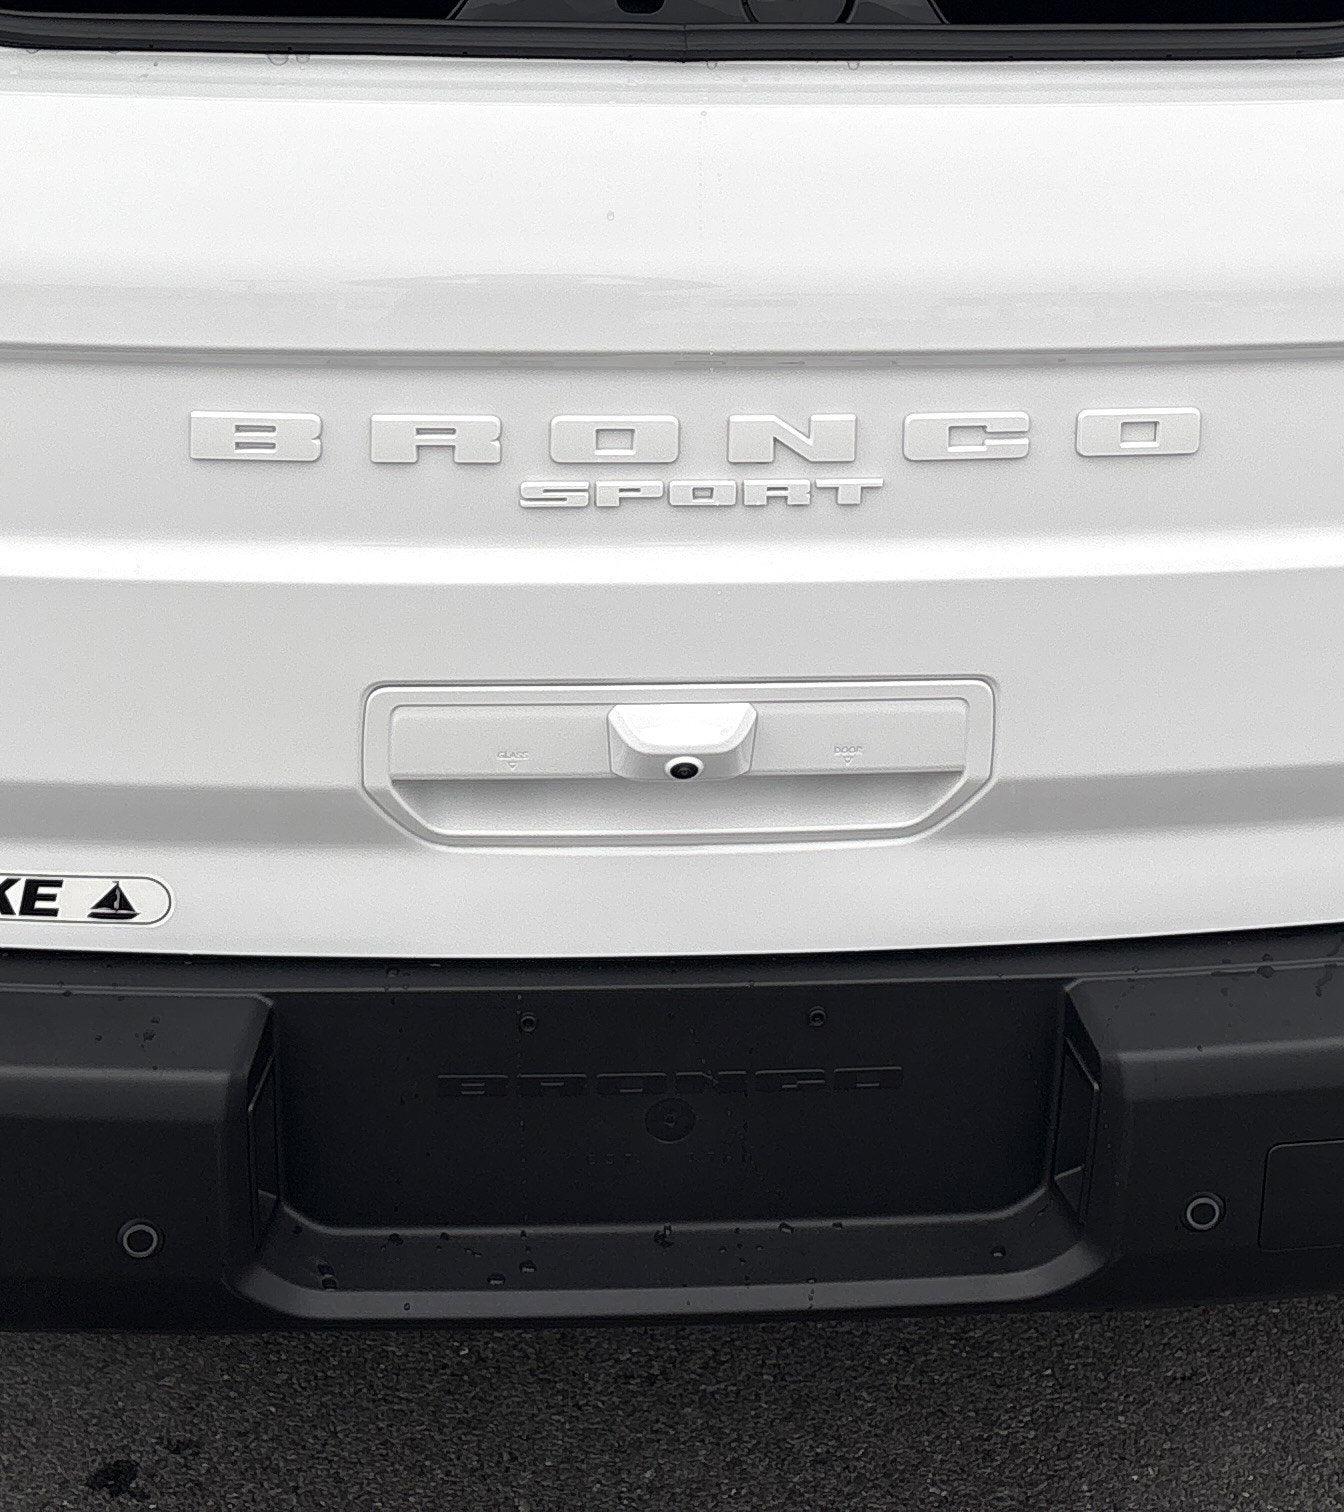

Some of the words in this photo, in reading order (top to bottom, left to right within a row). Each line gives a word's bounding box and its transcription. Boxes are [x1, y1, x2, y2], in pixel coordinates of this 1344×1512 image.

[188, 406, 1202, 464] BRONCO
[518, 476, 885, 508] SPORT
[436, 1065, 904, 1099] BRONCO
